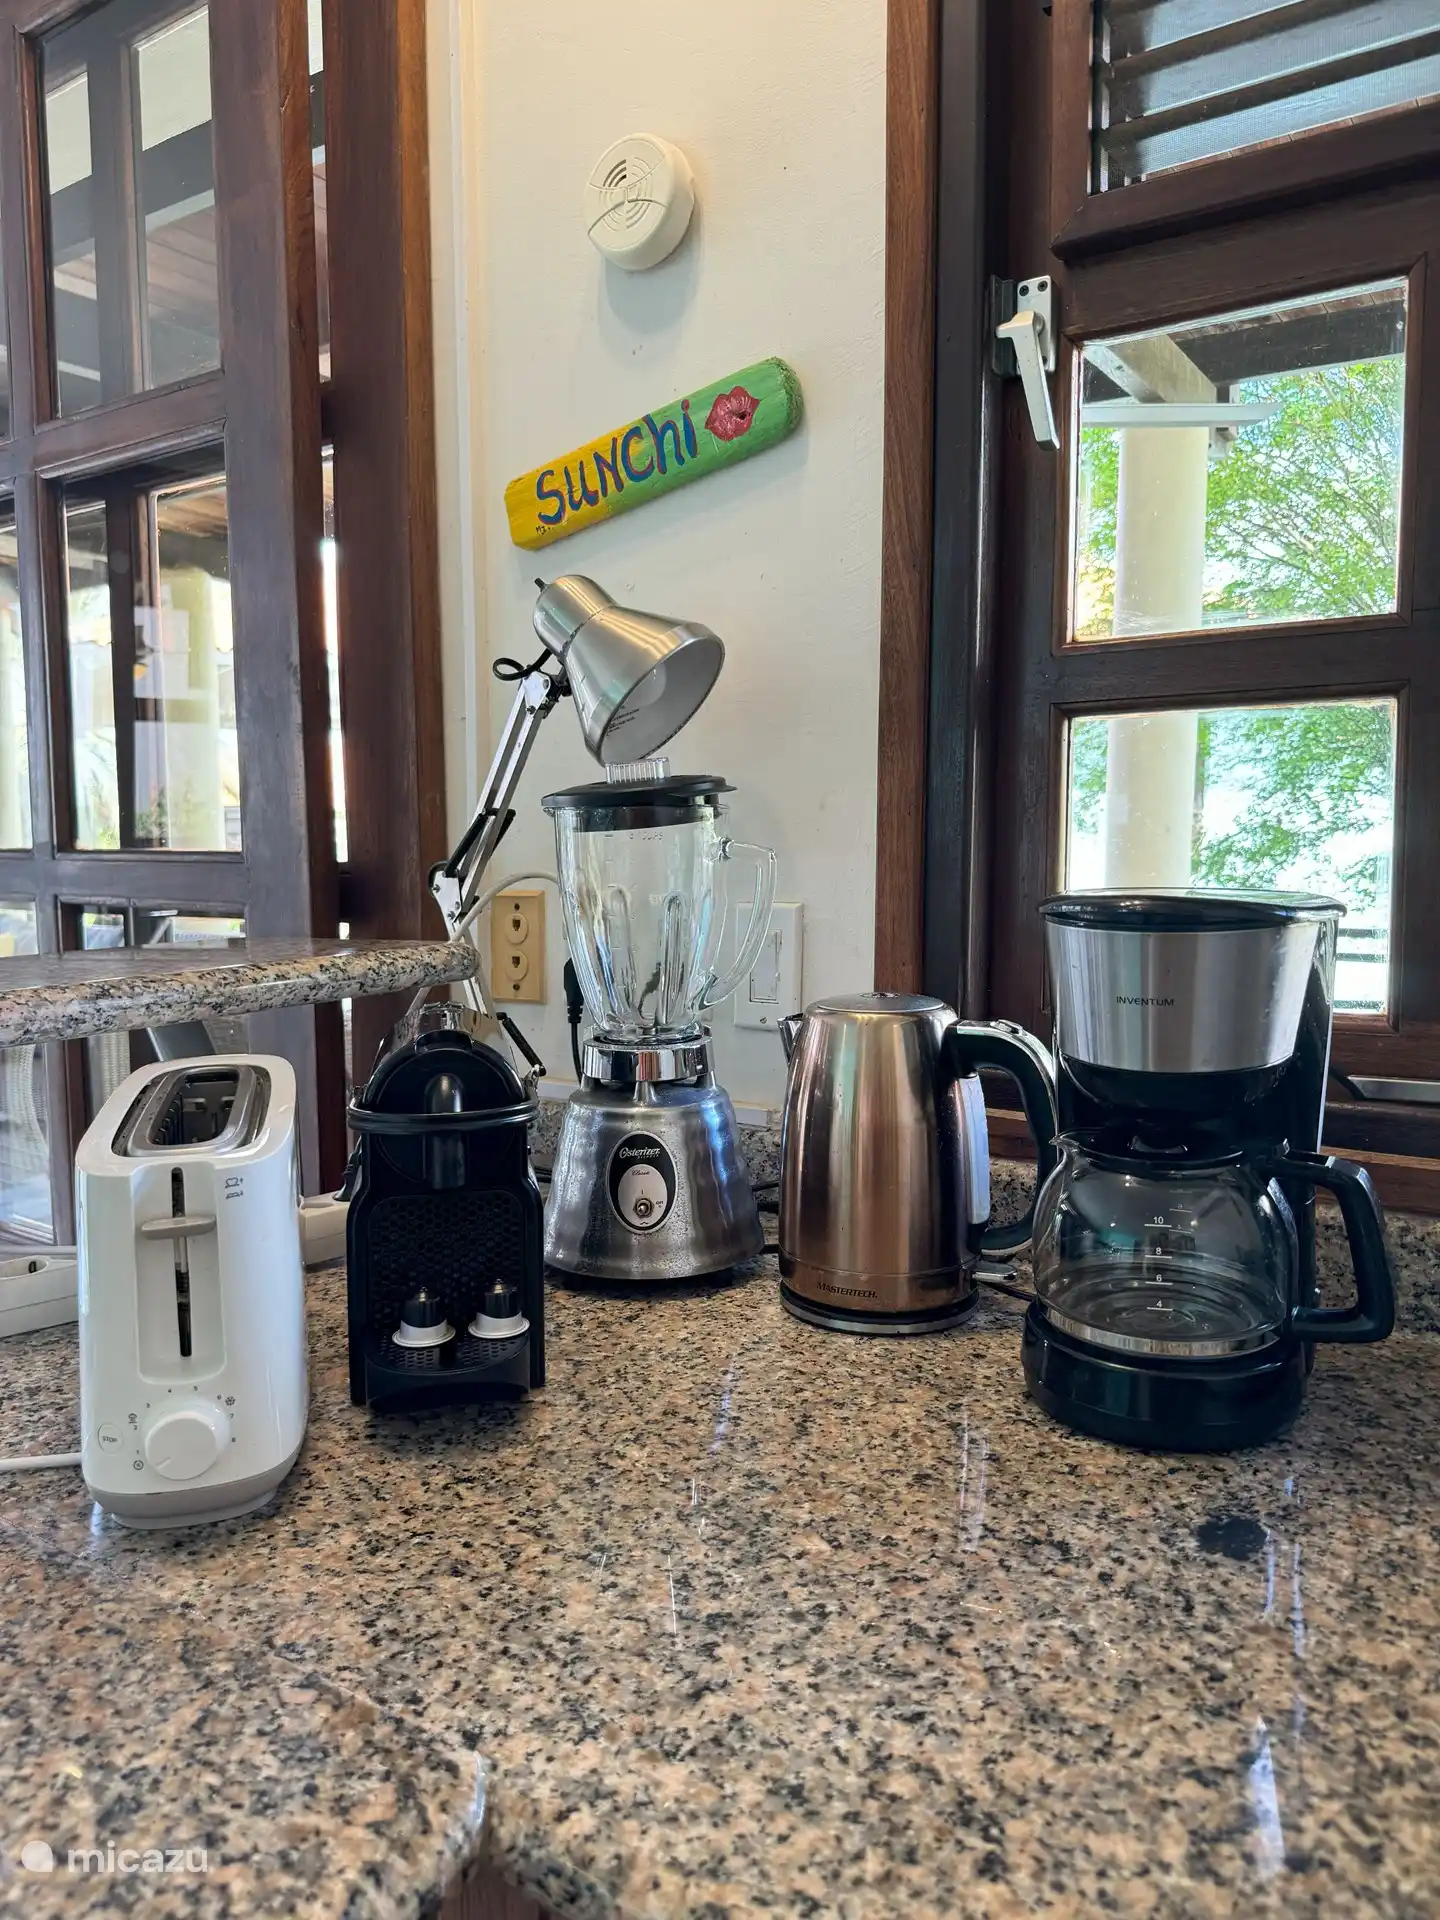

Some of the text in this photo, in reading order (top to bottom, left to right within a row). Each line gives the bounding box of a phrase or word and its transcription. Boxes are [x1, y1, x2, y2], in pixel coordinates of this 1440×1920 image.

[1116, 996, 1174, 1006] INVENTUM
[1153, 1216, 1164, 1225] 10
[1155, 1247, 1162, 1255] 8
[1156, 1274, 1162, 1282] 6
[1156, 1300, 1162, 1308] 4
[102, 1435, 118, 1443] STOP
